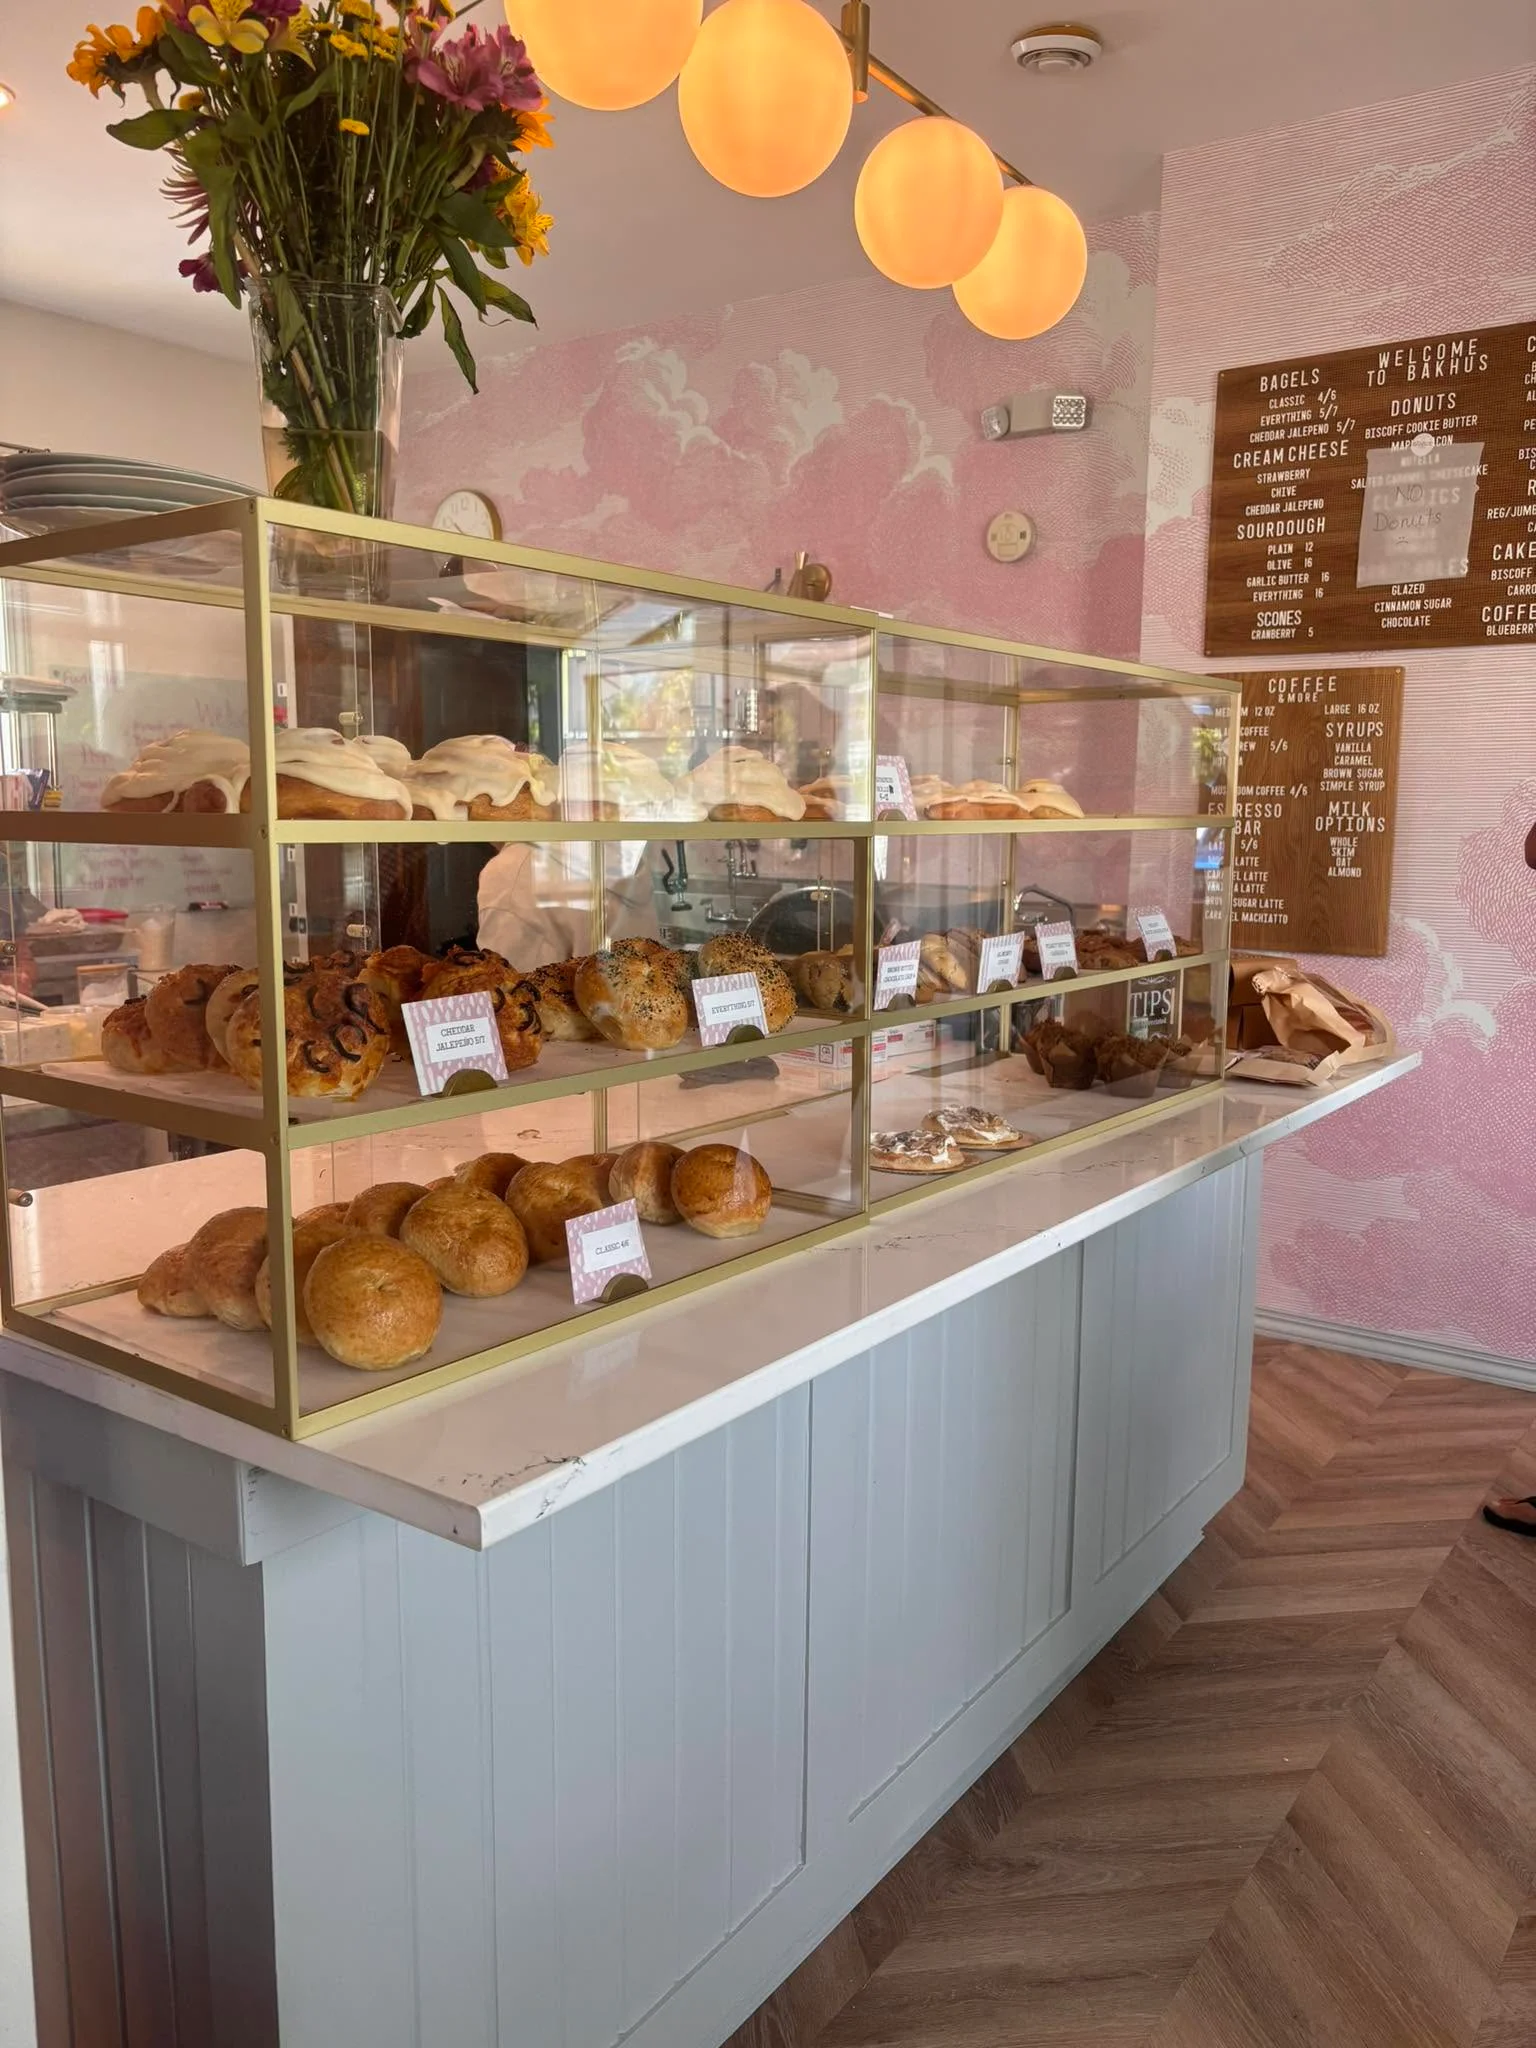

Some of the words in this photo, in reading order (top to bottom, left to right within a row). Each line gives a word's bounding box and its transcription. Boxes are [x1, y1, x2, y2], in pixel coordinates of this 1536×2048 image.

[1379, 338, 1478, 369] WELCOME
[1367, 369, 1386, 387] TO
[1407, 354, 1488, 381] BAKHUS
[1260, 368, 1320, 392] BAGELS
[1269, 394, 1306, 409] CLASSIC
[1317, 388, 1337, 404] 4/6
[1391, 392, 1456, 417] DONUTS
[1260, 410, 1312, 427] EVERYTHING
[1319, 404, 1338, 420] 5/7
[1249, 429, 1286, 443] CHEDDAR
[1287, 423, 1329, 438] JALEPENO
[1336, 418, 1356, 435] 5/7
[1365, 423, 1404, 439] BISCOFF
[1406, 419, 1440, 434] COOKIE
[1442, 414, 1478, 429] BUTTER
[1233, 447, 1284, 469] CREAM
[1288, 439, 1349, 462] CHEESE
[1257, 468, 1311, 484] STRAWBERRY
[1271, 485, 1297, 498] CHIVE
[1245, 503, 1281, 516] CHEDDAR
[1282, 498, 1324, 512] JALEPENO
[1372, 508, 1441, 532] Donuts
[1237, 517, 1326, 540] SOURDOUGH
[1267, 543, 1293, 556] PLAIN
[1305, 542, 1314, 552] 12
[1267, 559, 1293, 571] OLIVE
[1304, 557, 1313, 568] 16
[1246, 576, 1277, 588] GARLIC
[1278, 573, 1309, 586] BUTTER
[1321, 571, 1330, 583] 16
[1490, 567, 1533, 581] BISCOFF
[1253, 589, 1304, 603] EVERYTHING
[1315, 588, 1324, 598] 16
[1391, 583, 1425, 596] GLAZED
[1374, 600, 1421, 613] CINNAMON
[1423, 598, 1452, 610] SUGAR
[1257, 610, 1302, 628] SCONES
[1381, 615, 1431, 629] CHOCOLATE
[1251, 628, 1296, 640] CRANBERRY
[1307, 627, 1314, 637] 5
[1486, 624, 1536, 636] BLUEBERR
[1268, 676, 1337, 693] COFFEE
[1278, 694, 1285, 703] &
[1287, 691, 1319, 703] MORE
[1254, 706, 1262, 717] 12
[1264, 705, 1276, 716] OZ
[1324, 704, 1351, 715] LARGE
[1358, 703, 1366, 714] 16
[1368, 703, 1380, 714] OZ
[1325, 721, 1384, 738] SYRUPS
[1239, 741, 1256, 752] REW
[1270, 738, 1288, 754] 5/6
[1335, 742, 1372, 753] VANILLA
[1334, 755, 1373, 766] CARAMEL
[1323, 768, 1352, 779] BROWN
[1356, 768, 1383, 778] SUGAR
[1255, 785, 1286, 796] COFFEE
[1290, 783, 1308, 798] 4/6
[1320, 781, 1354, 792] SIMPLE
[1358, 781, 1385, 792] SYRUP
[1208, 803, 1282, 818] ESRESSO
[1328, 801, 1371, 817] MILK
[1234, 820, 1261, 836] BAR
[1315, 816, 1385, 833] OPTIONS
[1329, 836, 1358, 847] WHOLE
[1331, 847, 1355, 857] SKIM
[1235, 856, 1260, 867] LATTE
[1336, 857, 1352, 867] OAT
[1243, 871, 1269, 882] LATTE
[1327, 867, 1362, 878] ALMOND
[1240, 883, 1265, 894] LATTE
[1232, 898, 1257, 909] SUGAR
[1259, 899, 1284, 910] LATTE
[1241, 912, 1288, 925] MACHIATTO
[1130, 988, 1171, 1018] TIPS
[440, 1024, 476, 1037] CHEDDAR
